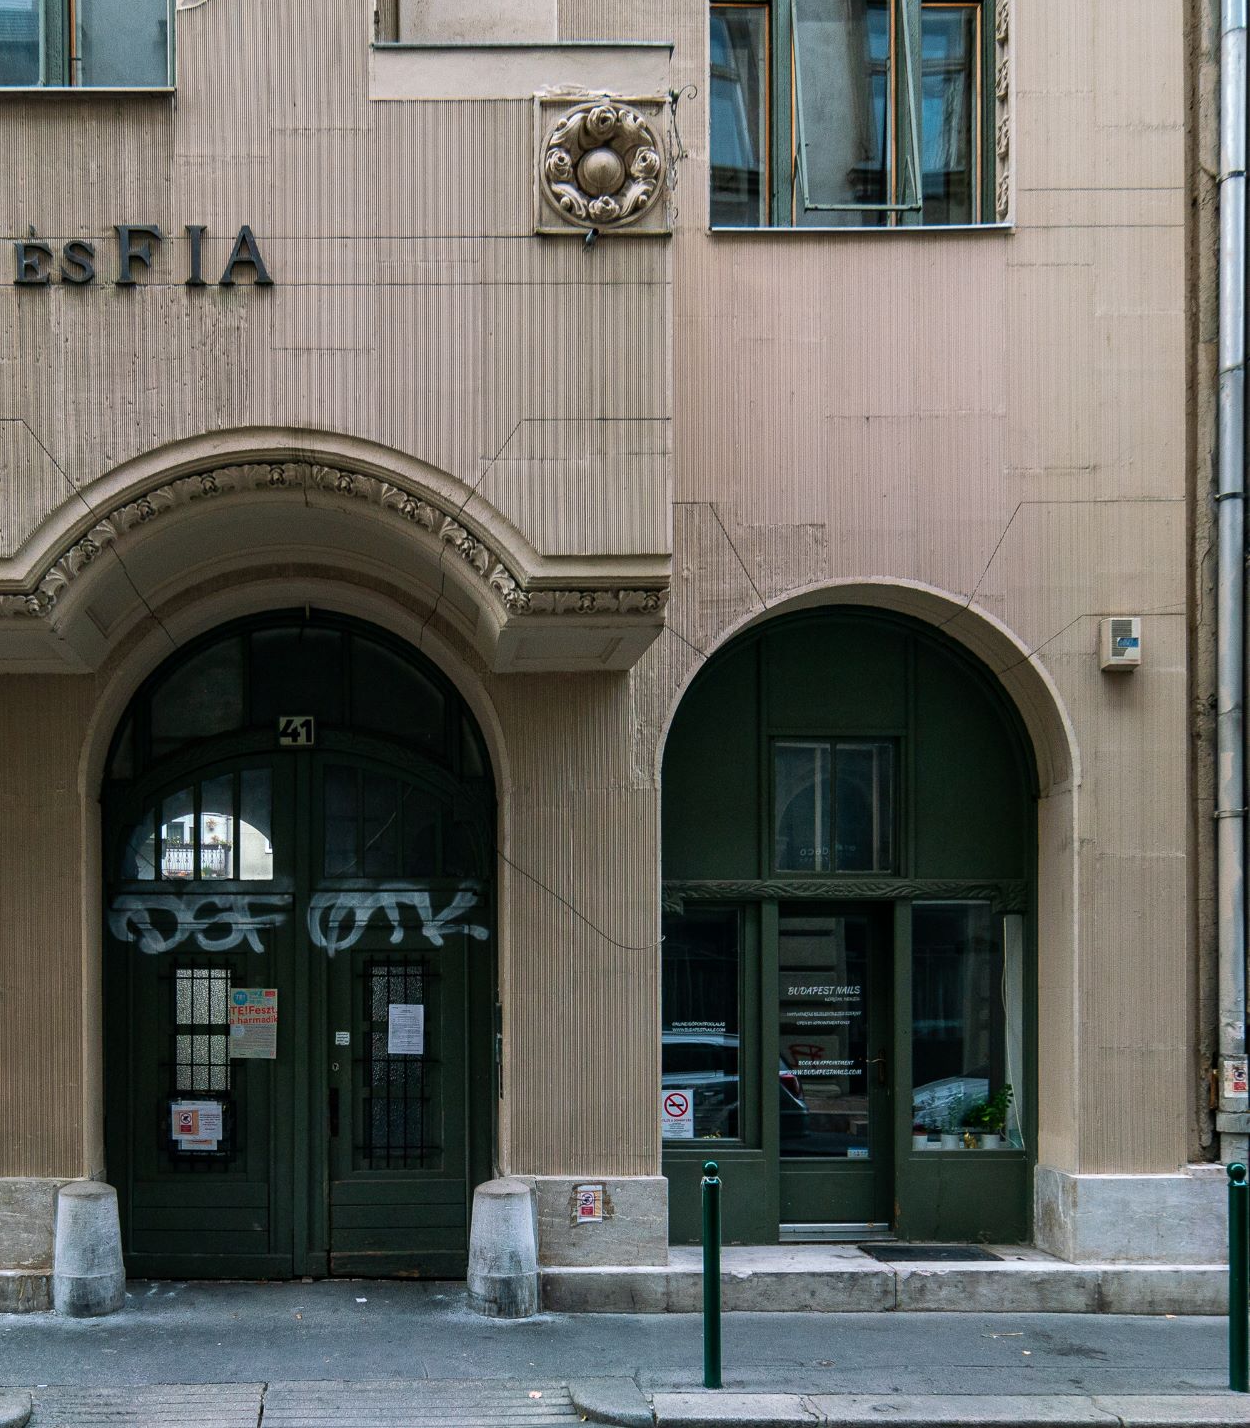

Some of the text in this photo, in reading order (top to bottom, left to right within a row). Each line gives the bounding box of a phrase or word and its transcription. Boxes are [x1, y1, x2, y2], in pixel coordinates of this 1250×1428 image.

[113, 224, 275, 286] FIA
[280, 718, 313, 743] 41
[787, 985, 861, 995] BUDAPEST NAILS
[237, 1015, 278, 1024] harmadik
